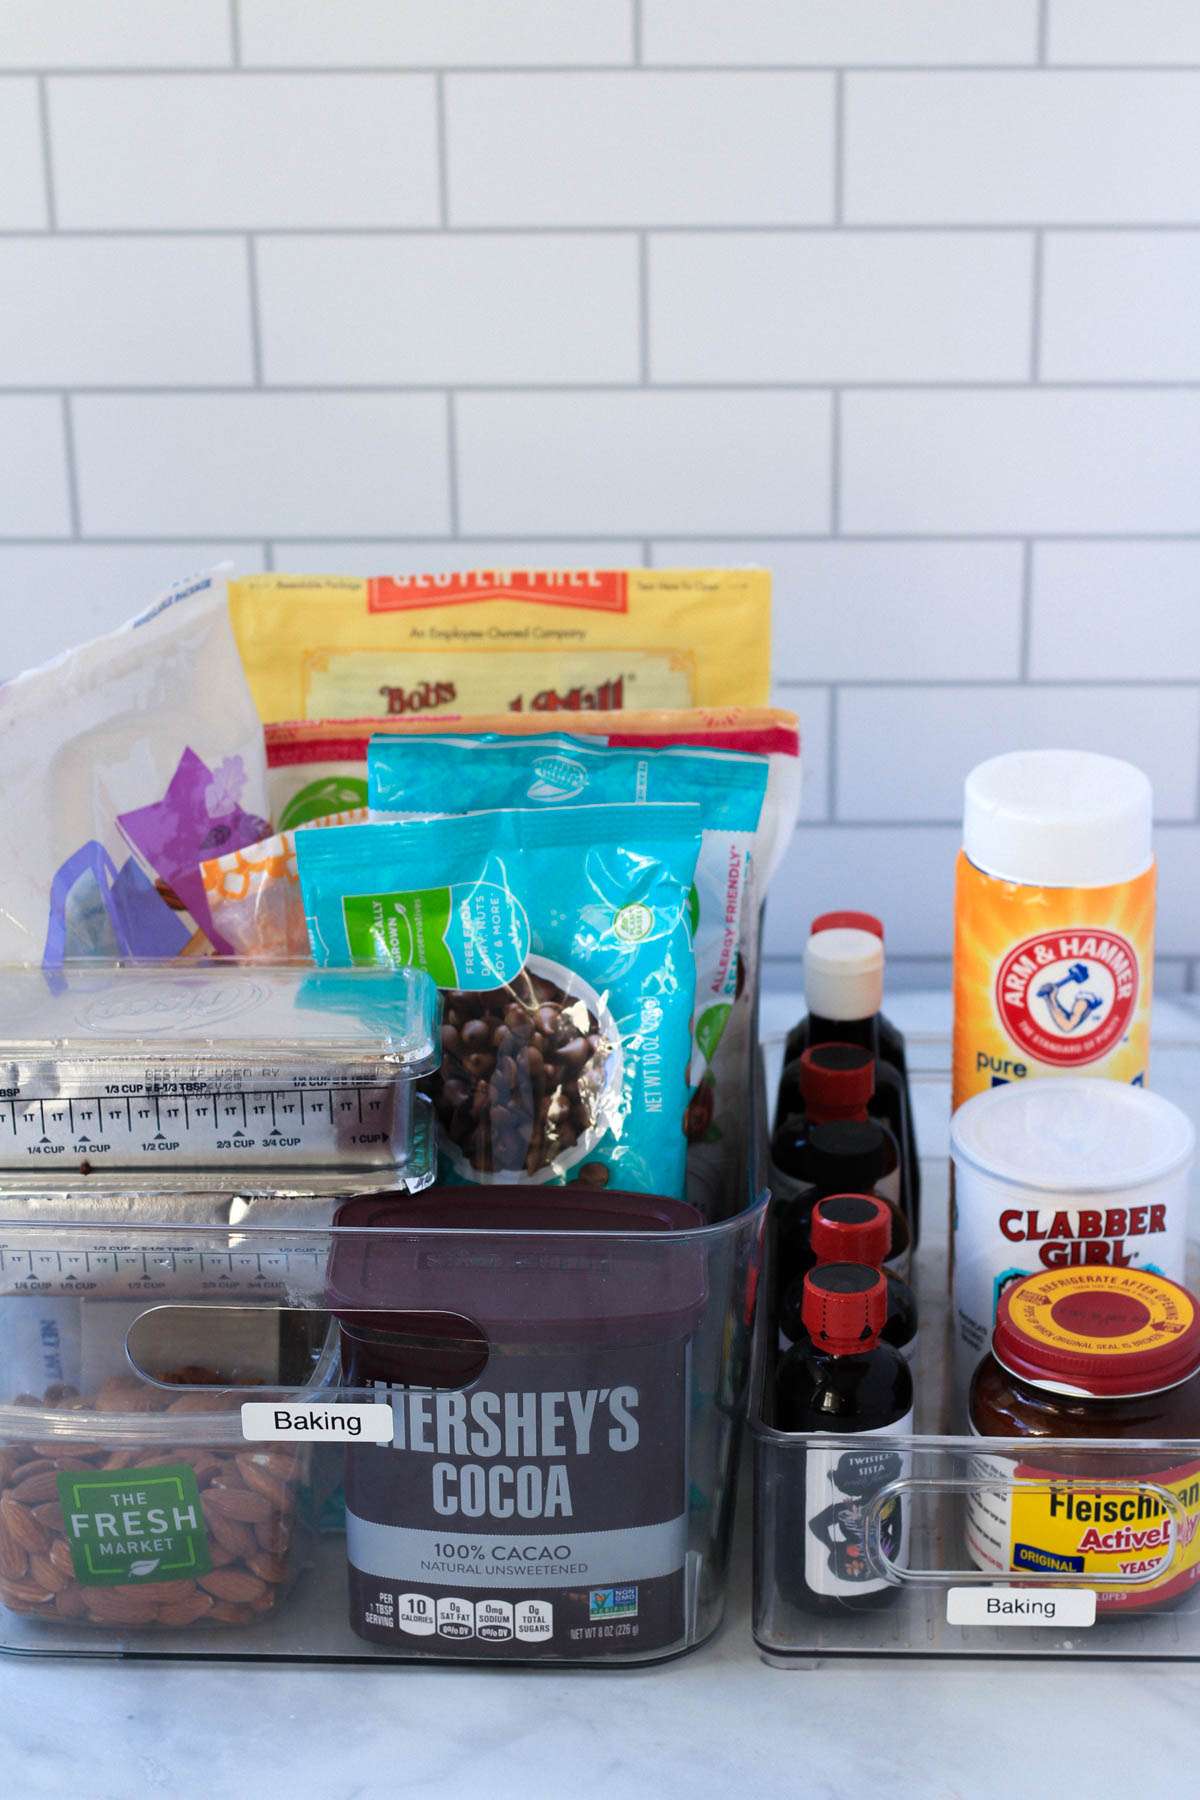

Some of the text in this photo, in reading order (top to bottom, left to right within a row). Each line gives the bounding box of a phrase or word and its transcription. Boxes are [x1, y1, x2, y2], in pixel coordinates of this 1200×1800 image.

[475, 895, 488, 931] NUTS
[463, 940, 476, 975] FREE
[710, 927, 736, 993] ALLERGY
[1004, 937, 1133, 1008] ARM & HAMMER
[642, 1034, 660, 1051] OZ
[642, 1053, 662, 1066] 10
[976, 1051, 1028, 1078] pure
[643, 1069, 662, 1088] WT
[105, 1085, 119, 1094] 1/3
[121, 1084, 143, 1094] CUP
[179, 1083, 207, 1092] TBSP
[311, 1104, 324, 1112] 1T
[340, 1102, 353, 1111] 1T
[369, 1101, 382, 1110] 1T
[644, 1092, 663, 1113] NET
[109, 1111, 122, 1119] 1T
[138, 1110, 150, 1118] 1T
[167, 1109, 179, 1118] 1T
[196, 1108, 208, 1117] 1T
[224, 1107, 237, 1116] 1T
[253, 1106, 266, 1115] 1T
[282, 1105, 295, 1114] 1T
[23, 1113, 35, 1122] 1T
[52, 1113, 64, 1121] 1T
[80, 1112, 93, 1120] 1T
[216, 1139, 255, 1149] 2/3 CUP
[262, 1138, 301, 1147] 3/4 CUP
[359, 1135, 382, 1144] CUP
[27, 1145, 65, 1155] 1/4 CUP
[73, 1144, 111, 1154] 1/3 CUP
[142, 1142, 180, 1152] 1/2 CUP
[999, 1204, 1167, 1242] CLABBER
[1038, 1239, 1133, 1269] GIRL
[30, 1281, 52, 1289] CUP
[75, 1281, 97, 1289] CUP
[143, 1281, 165, 1289] CUP
[218, 1281, 240, 1289] CUP
[1039, 1275, 1117, 1294] REFRIGERATE
[1122, 1278, 1157, 1297] AFTER
[274, 1411, 362, 1436] Baking
[374, 1381, 640, 1457] HERSHEY'S
[432, 1462, 573, 1518] COCOA
[110, 1492, 148, 1507] THE
[70, 1505, 198, 1538] FRESH
[99, 1537, 175, 1556] MARKET
[434, 1543, 571, 1561] 100% CACAO
[1020, 1549, 1076, 1572] ORIGINAL
[1120, 1557, 1162, 1574] YEAST
[421, 1559, 588, 1577] NATURAL UNSWEETENED
[615, 1588, 635, 1596] NON
[379, 1592, 393, 1604] PER
[375, 1603, 393, 1616] TBSP
[407, 1598, 426, 1615] 10
[485, 1604, 503, 1615] 0mg
[528, 1605, 540, 1615] 0g
[986, 1598, 1056, 1617] Baking
[365, 1612, 394, 1628] SERVING
[401, 1613, 434, 1624] CALORIES
[440, 1612, 471, 1622] SAT FAT
[479, 1615, 510, 1623] SODIUM
[522, 1616, 546, 1624] TOTAL
[518, 1624, 550, 1633] SUGARS
[570, 1628, 584, 1640] NET
[585, 1627, 597, 1639] WT
[604, 1625, 614, 1637] OZ
